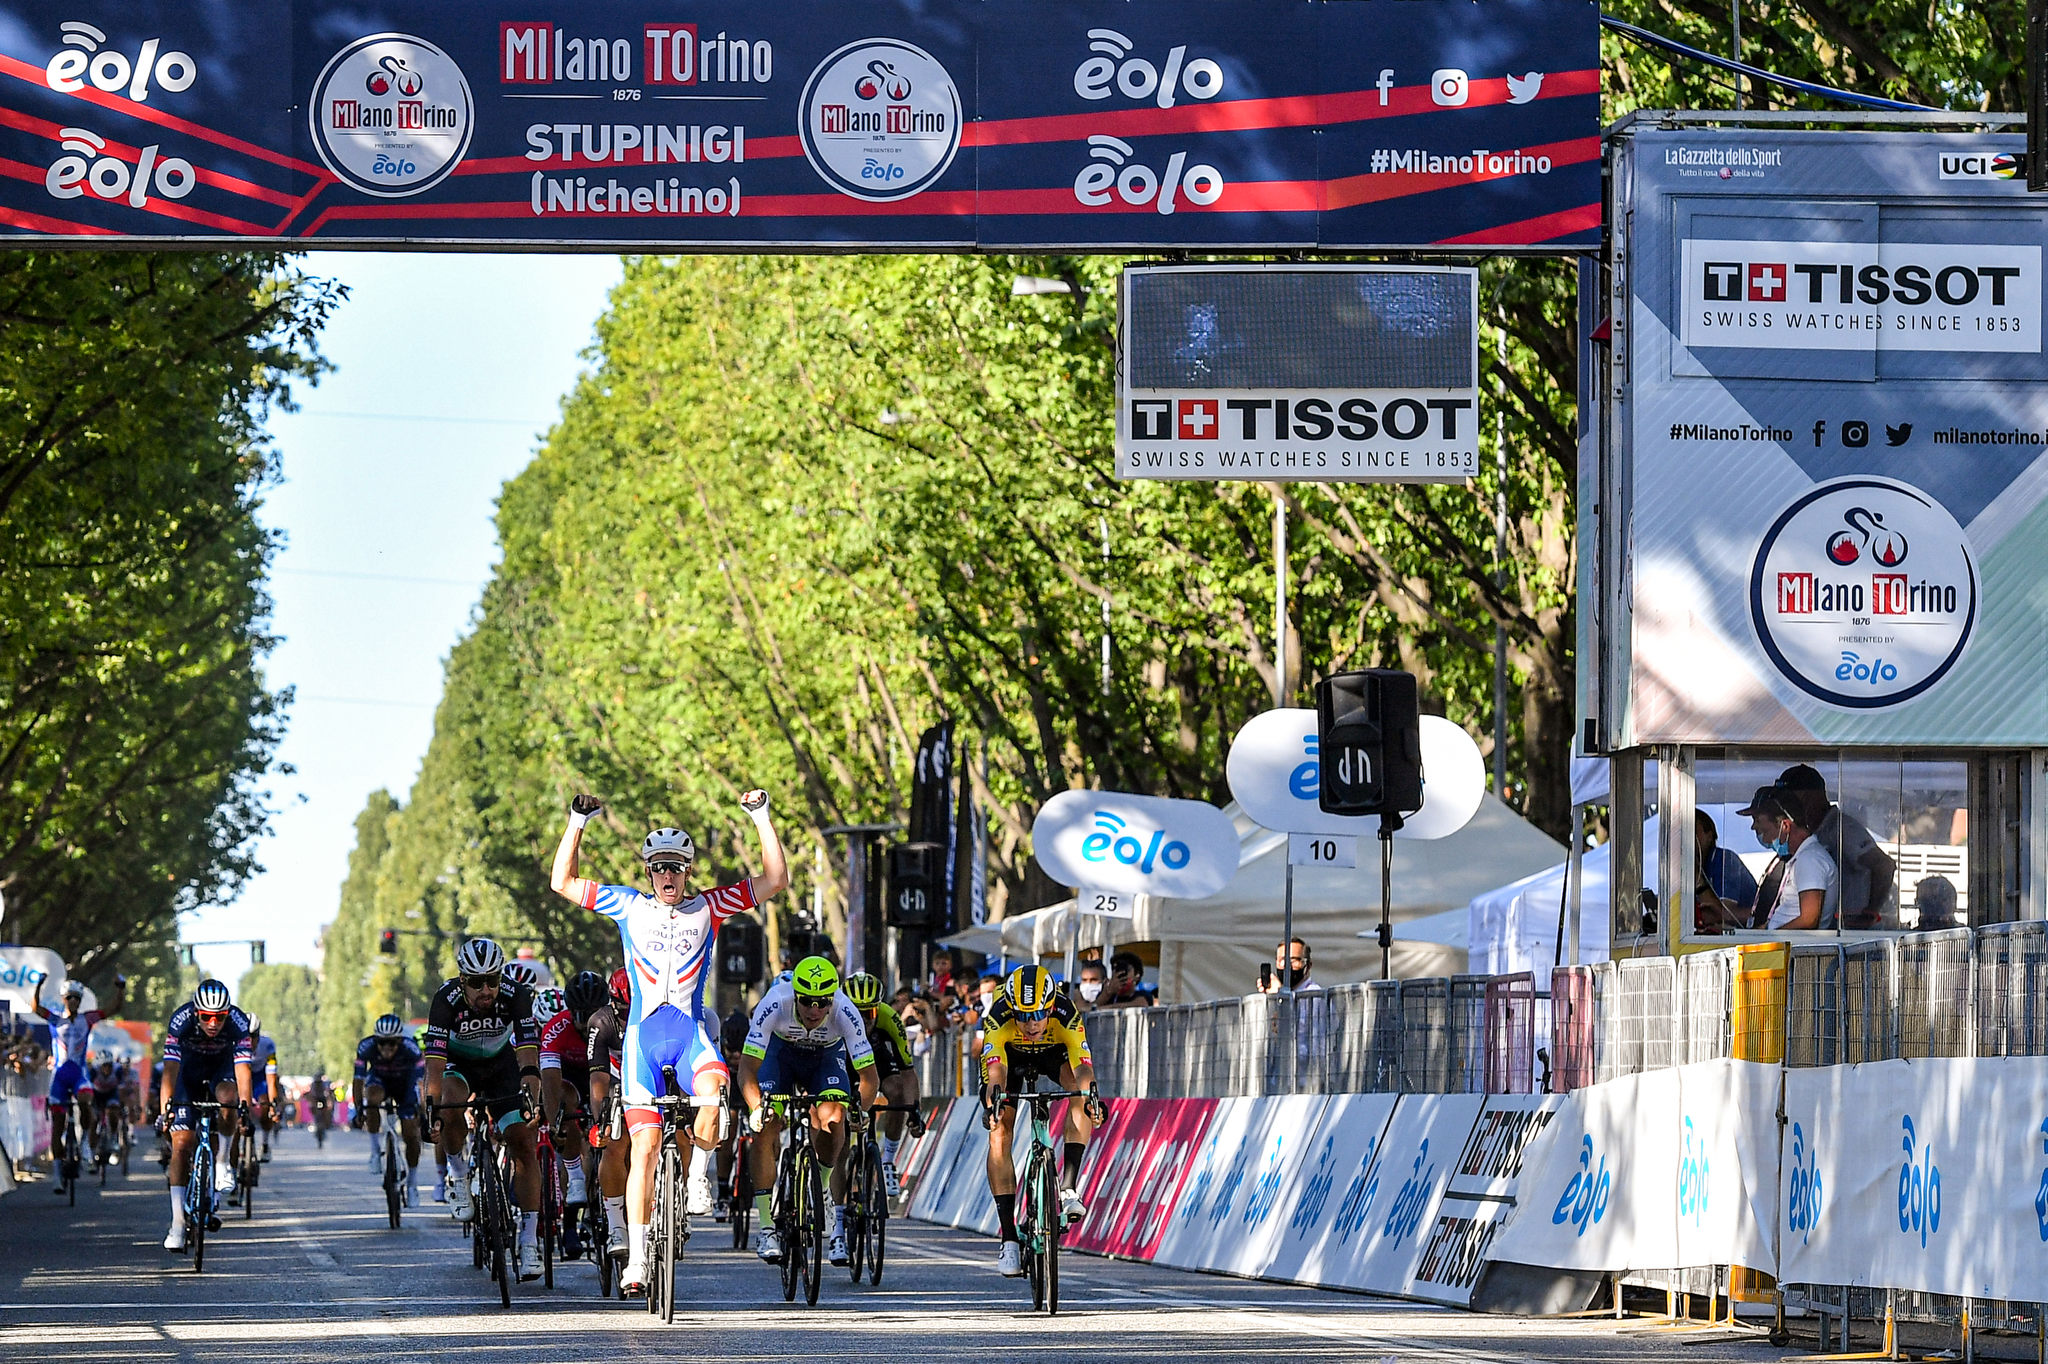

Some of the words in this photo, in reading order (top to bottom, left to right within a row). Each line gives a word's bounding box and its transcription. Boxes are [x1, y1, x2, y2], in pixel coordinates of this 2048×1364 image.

[46, 38, 197, 101] eolo
[1074, 45, 1223, 109] eolo
[612, 89, 642, 101] 1876
[525, 124, 745, 163] STUPINIGI
[1679, 147, 1725, 165] Gazzetta
[1726, 148, 1751, 166] dello
[1752, 148, 1781, 168] Sport
[46, 145, 196, 208] eolo
[372, 158, 416, 176] eolo
[861, 163, 904, 181] eolo
[1371, 150, 1552, 175] #MilanoTorino
[1942, 157, 1986, 175] UCI
[531, 171, 741, 217] (Nichelino)
[1074, 152, 1223, 215] eolo
[1794, 264, 2020, 306] TISSOT
[1703, 313, 1773, 328] SWISS
[1786, 314, 1883, 330] WATCHES
[1897, 315, 1961, 331] SINCE
[1975, 317, 2022, 332] 1853
[1227, 398, 1472, 440] TISSOT
[1670, 423, 1793, 442] #MilanoTorino
[1131, 451, 1205, 467] SWISS
[1219, 451, 1327, 467] WATCHES
[1342, 451, 1410, 467] SINCE
[1424, 451, 1473, 467] 1853
[1851, 617, 1871, 626] 1876
[1838, 635, 1883, 643] PRESENTED
[1835, 658, 1898, 685] eolo
[1082, 830, 1190, 874] eolo
[1309, 840, 1337, 861] 10
[1095, 895, 1118, 912] 25
[3, 965, 41, 987] olo
[1023, 984, 1033, 1004] WOUT
[170, 1008, 192, 1031] FENIX
[428, 1025, 448, 1034] BORA
[459, 1017, 505, 1033] BORA
[541, 1018, 571, 1049] ARKEA
[1079, 1110, 1162, 1241] enel
[1121, 1110, 1207, 1249] enel
[1680, 1138, 1709, 1228] eolo
[1243, 1157, 1285, 1235] eolo
[1293, 1159, 1336, 1241] eolo
[1384, 1163, 1434, 1251] eolo
[1552, 1154, 1610, 1237] eolo
[1789, 1147, 1823, 1246] eolo
[1898, 1144, 1941, 1250] eolo
[1436, 1218, 1507, 1289] TISSO
